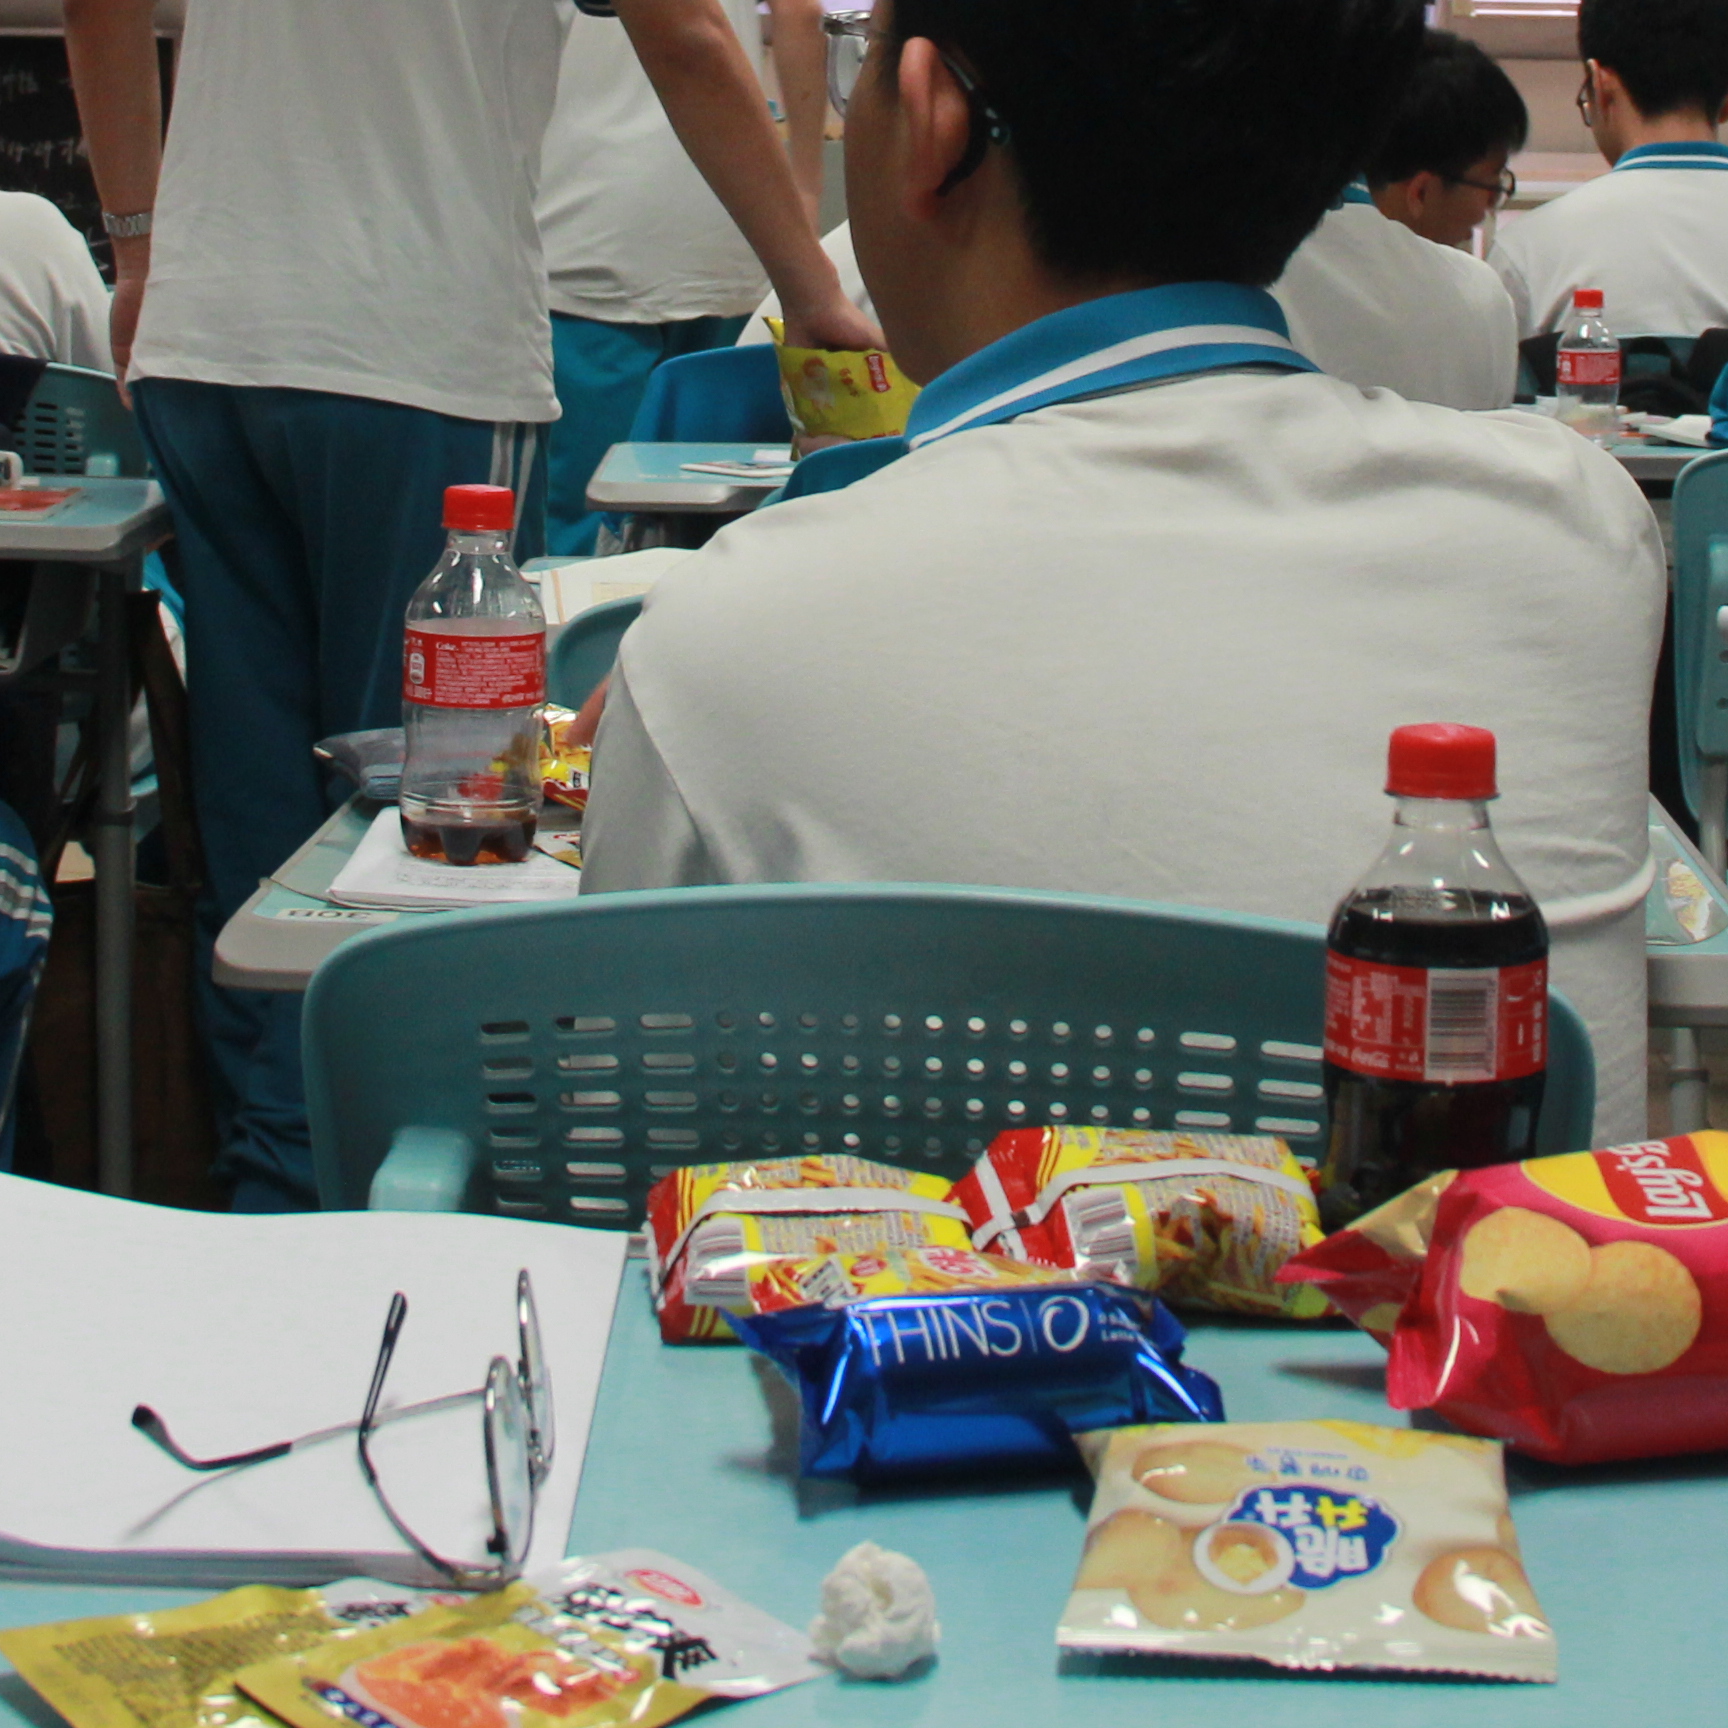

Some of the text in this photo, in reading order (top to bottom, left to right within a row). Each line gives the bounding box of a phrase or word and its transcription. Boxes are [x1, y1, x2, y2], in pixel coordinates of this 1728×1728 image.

[1614, 1154, 1714, 1220] Lay's
[854, 1298, 1023, 1367] THINS
[1254, 1489, 1370, 1530] 升升
[1292, 1524, 1370, 1578] 脆
